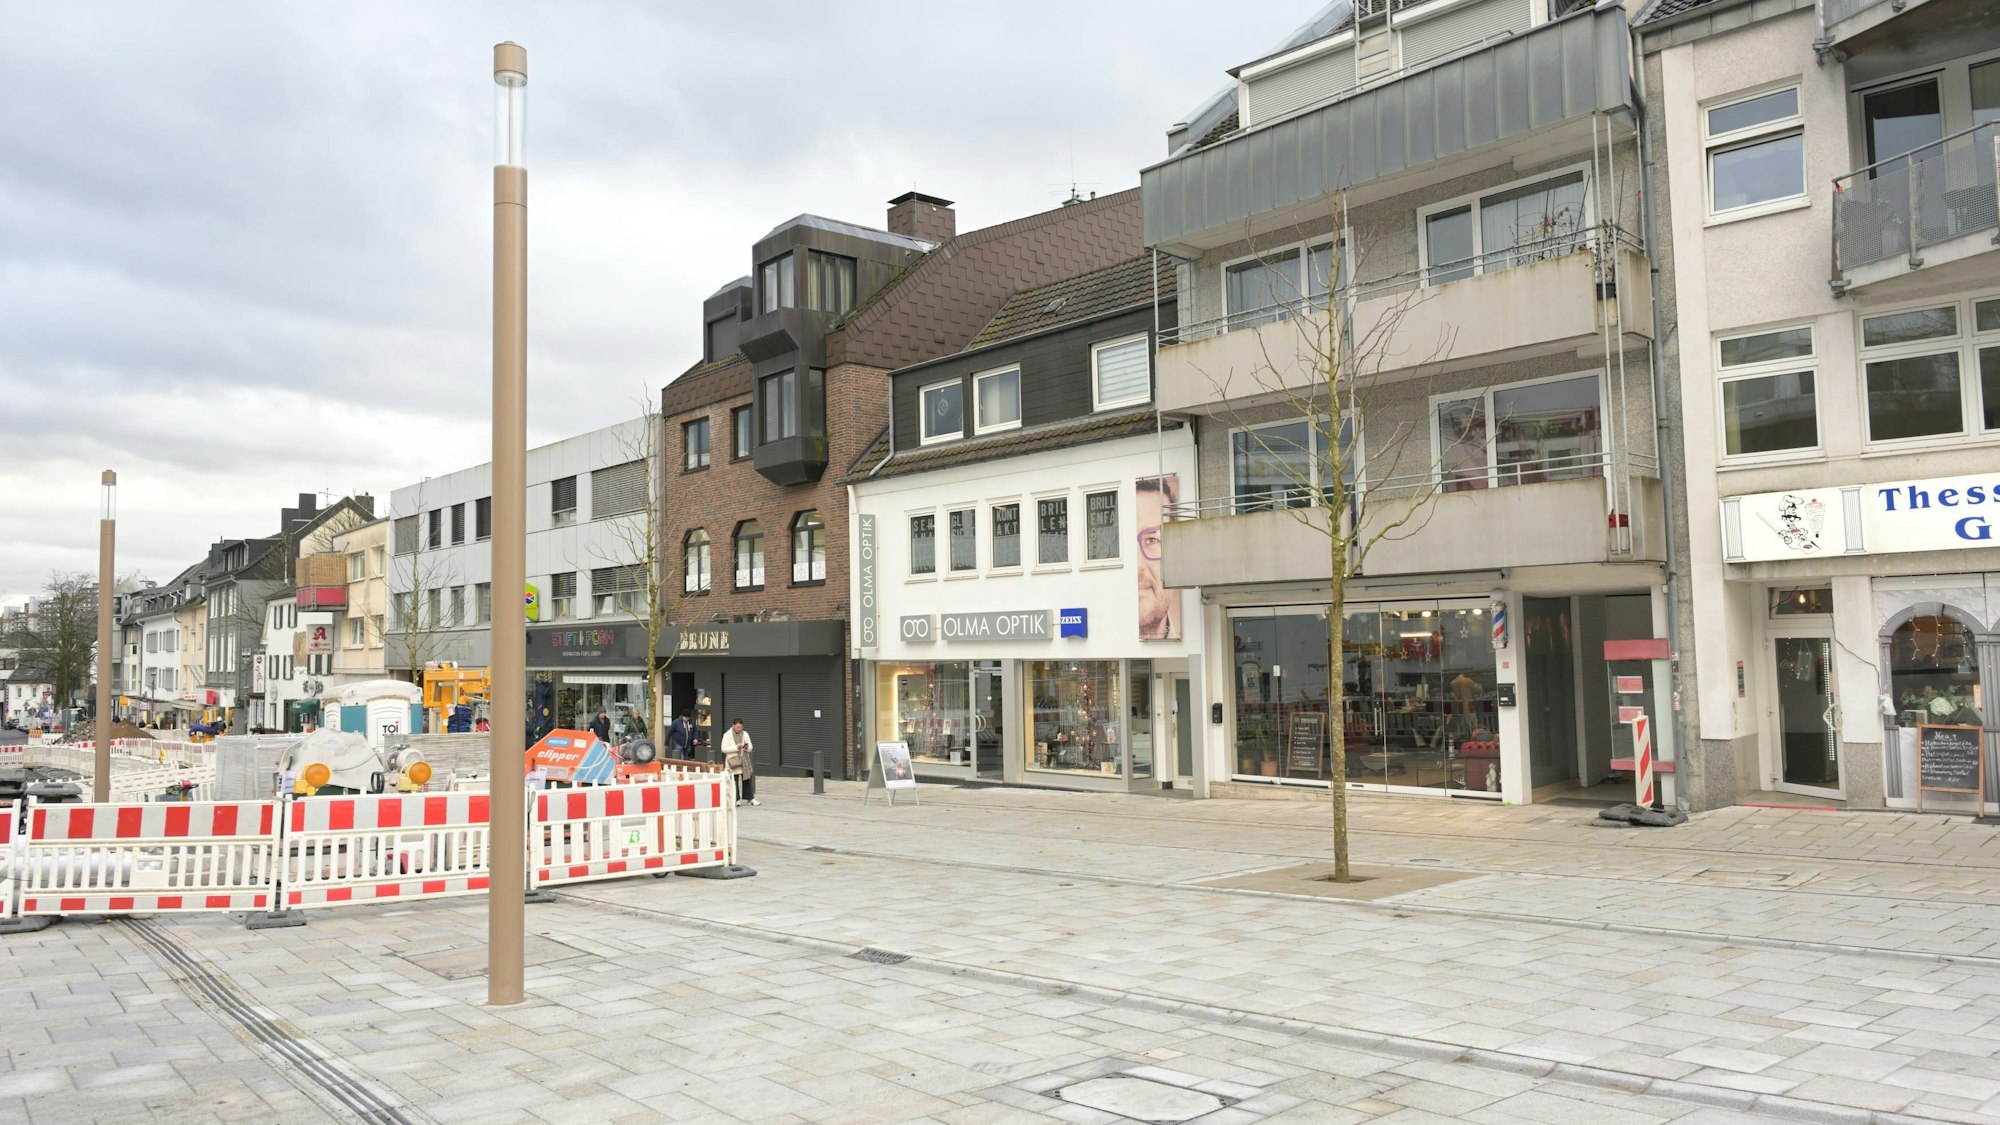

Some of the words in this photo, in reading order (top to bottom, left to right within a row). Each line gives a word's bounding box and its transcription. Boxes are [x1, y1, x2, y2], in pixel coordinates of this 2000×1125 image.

[1041, 501, 1066, 516] BRIL
[1090, 496, 1115, 510] BRILL
[996, 508, 1017, 521] KONT
[1091, 511, 1115, 525] ENFA
[996, 522, 1018, 535] AKT
[1041, 516, 1066, 530] LEN
[862, 518, 873, 560] OPTIK
[863, 565, 874, 608] OLMA
[943, 616, 990, 637] OLMA
[996, 614, 1045, 636] OPTIK
[1060, 616, 1082, 625] ZEISS
[551, 630, 578, 647] STIFT
[585, 629, 614, 646] FORM
[679, 631, 730, 650] BRUNE
[537, 749, 580, 762] clipper
